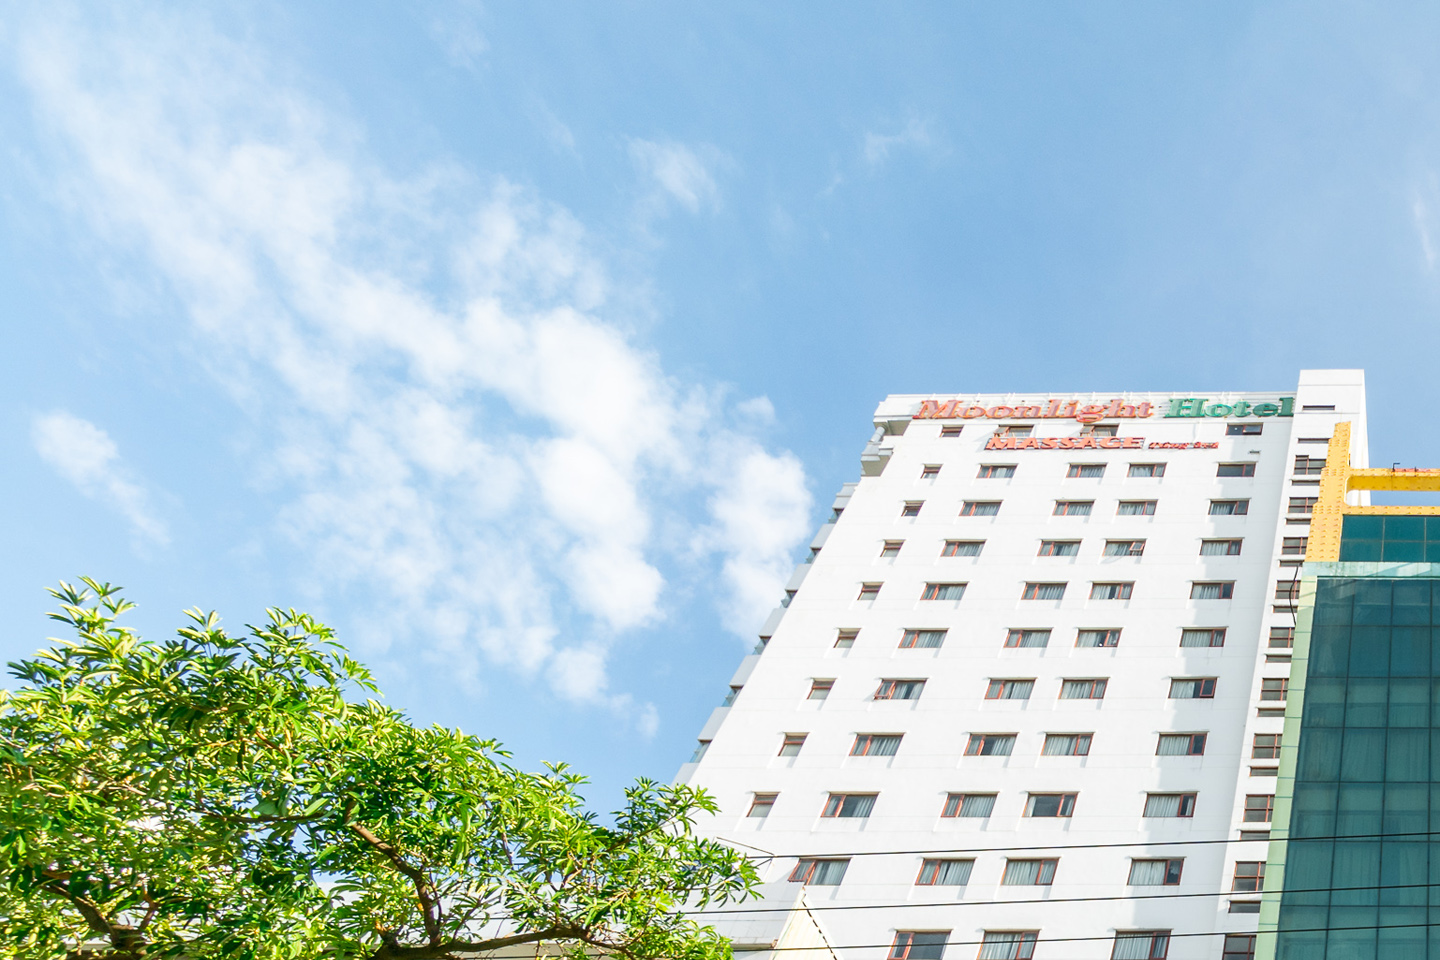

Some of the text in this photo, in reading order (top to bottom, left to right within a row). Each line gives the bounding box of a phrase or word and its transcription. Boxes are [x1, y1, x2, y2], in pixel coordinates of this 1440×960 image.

[912, 397, 1295, 423] Moonlight Hotel
[985, 436, 1146, 451] MASSAGE
